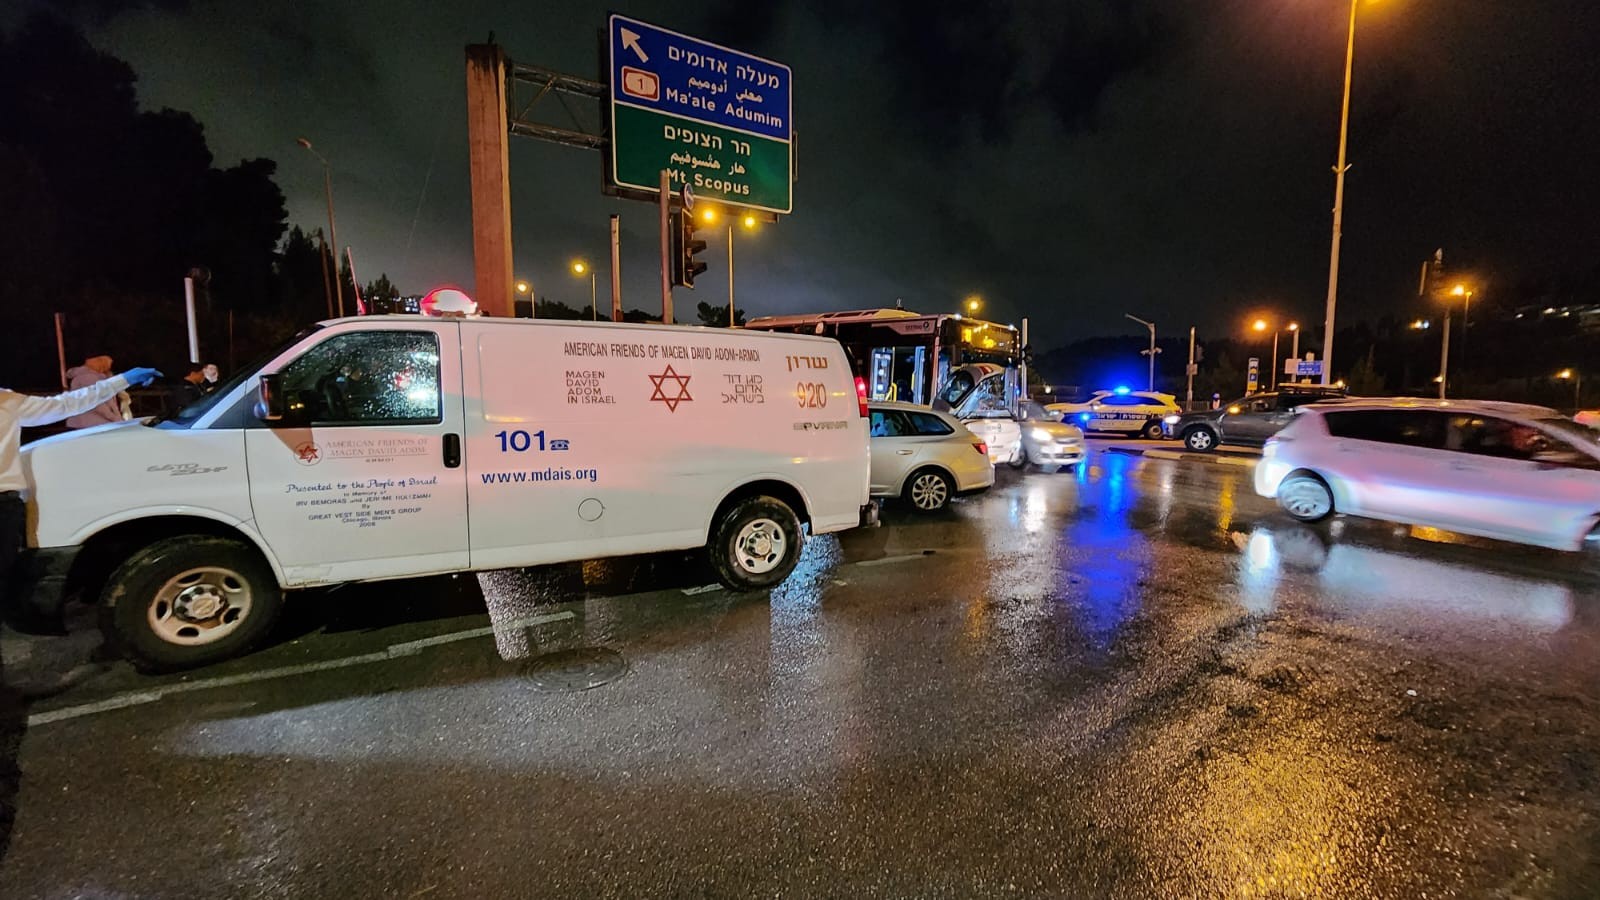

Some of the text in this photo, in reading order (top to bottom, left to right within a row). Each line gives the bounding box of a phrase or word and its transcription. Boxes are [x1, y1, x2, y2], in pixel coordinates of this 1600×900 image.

[668, 45, 780, 89] מעלה אדומים
[637, 77, 644, 91] 1
[666, 87, 782, 129] Ma'ale Adumim
[664, 125, 751, 157] הר הצופים
[666, 168, 750, 196] Mt Scopus
[564, 341, 608, 357] AMERICAN
[611, 343, 646, 358] FRIENDS
[648, 344, 659, 359] OF
[661, 345, 689, 360] MAGEN
[690, 346, 712, 361] DAVID
[786, 355, 828, 372] שרון
[566, 371, 605, 379] MAGEN
[723, 374, 763, 385] מגן דוד
[566, 379, 600, 387] DAVID
[734, 384, 763, 394] אדום
[567, 387, 602, 395] ADOM
[721, 392, 765, 404] בישראל
[797, 382, 827, 409] 920
[567, 396, 617, 404] IN ISRAEL
[326, 440, 374, 448] AMERICAN
[377, 439, 415, 447] FRIENDS
[494, 430, 545, 452] 101
[330, 446, 426, 456] MAGEN DAVID ADOM
[481, 467, 597, 484] www.mdais.org
[285, 483, 333, 493] Presented
[351, 481, 365, 489] the
[367, 479, 395, 489] People
[398, 480, 406, 488] of
[408, 476, 437, 486] Israel
[308, 513, 332, 521] GREAT
